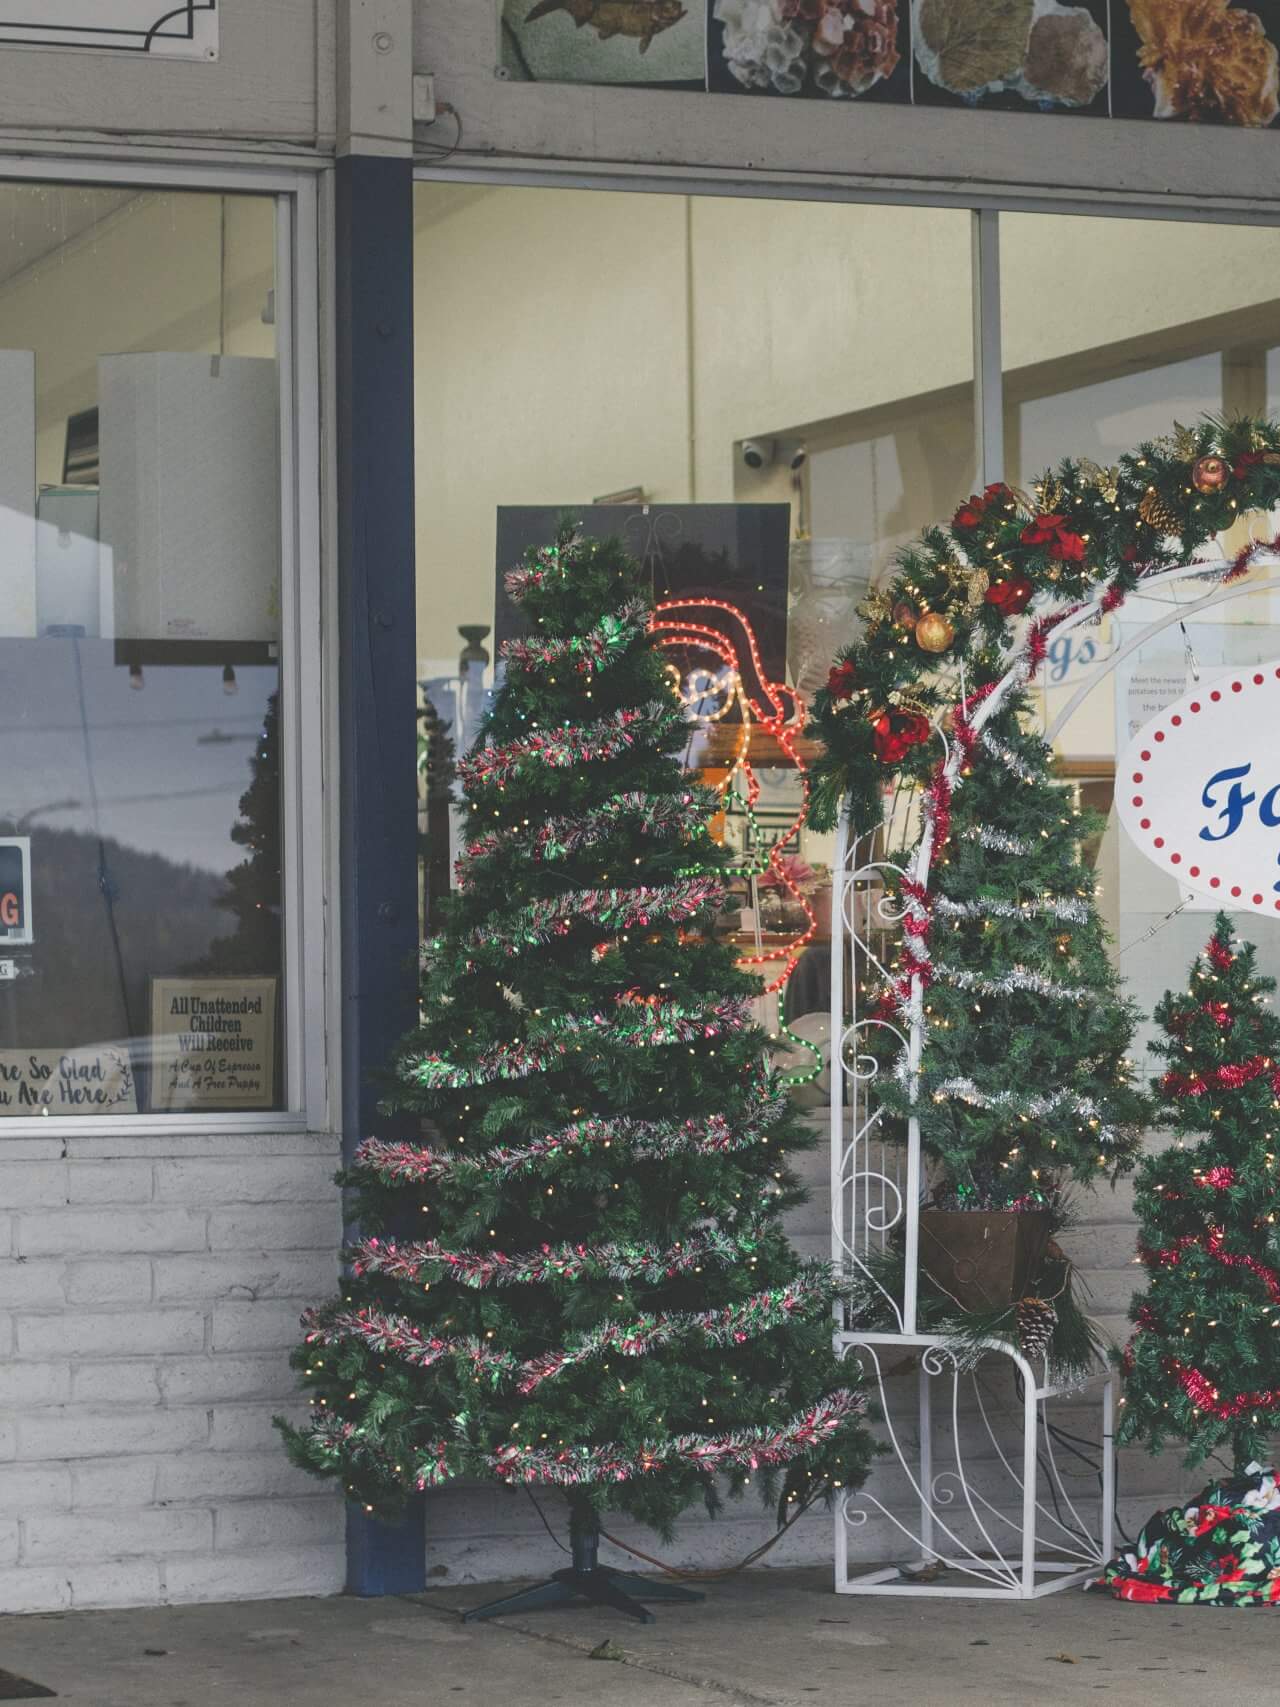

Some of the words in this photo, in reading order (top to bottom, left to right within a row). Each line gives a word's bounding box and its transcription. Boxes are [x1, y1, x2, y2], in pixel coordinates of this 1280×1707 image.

[170, 997, 189, 1014] All
[190, 997, 262, 1014] Unattended
[190, 1016, 241, 1033] Children
[179, 1034, 204, 1051] Will
[206, 1034, 253, 1051] Receive
[29, 1056, 52, 1080] So
[59, 1056, 105, 1082] Glad
[181, 1059, 202, 1073] Cup
[204, 1059, 216, 1075] Of
[218, 1058, 261, 1074] Espresso
[192, 1077, 202, 1088] A
[203, 1076, 225, 1091] Free
[227, 1076, 260, 1091] Puppy
[19, 1081, 54, 1106] Are
